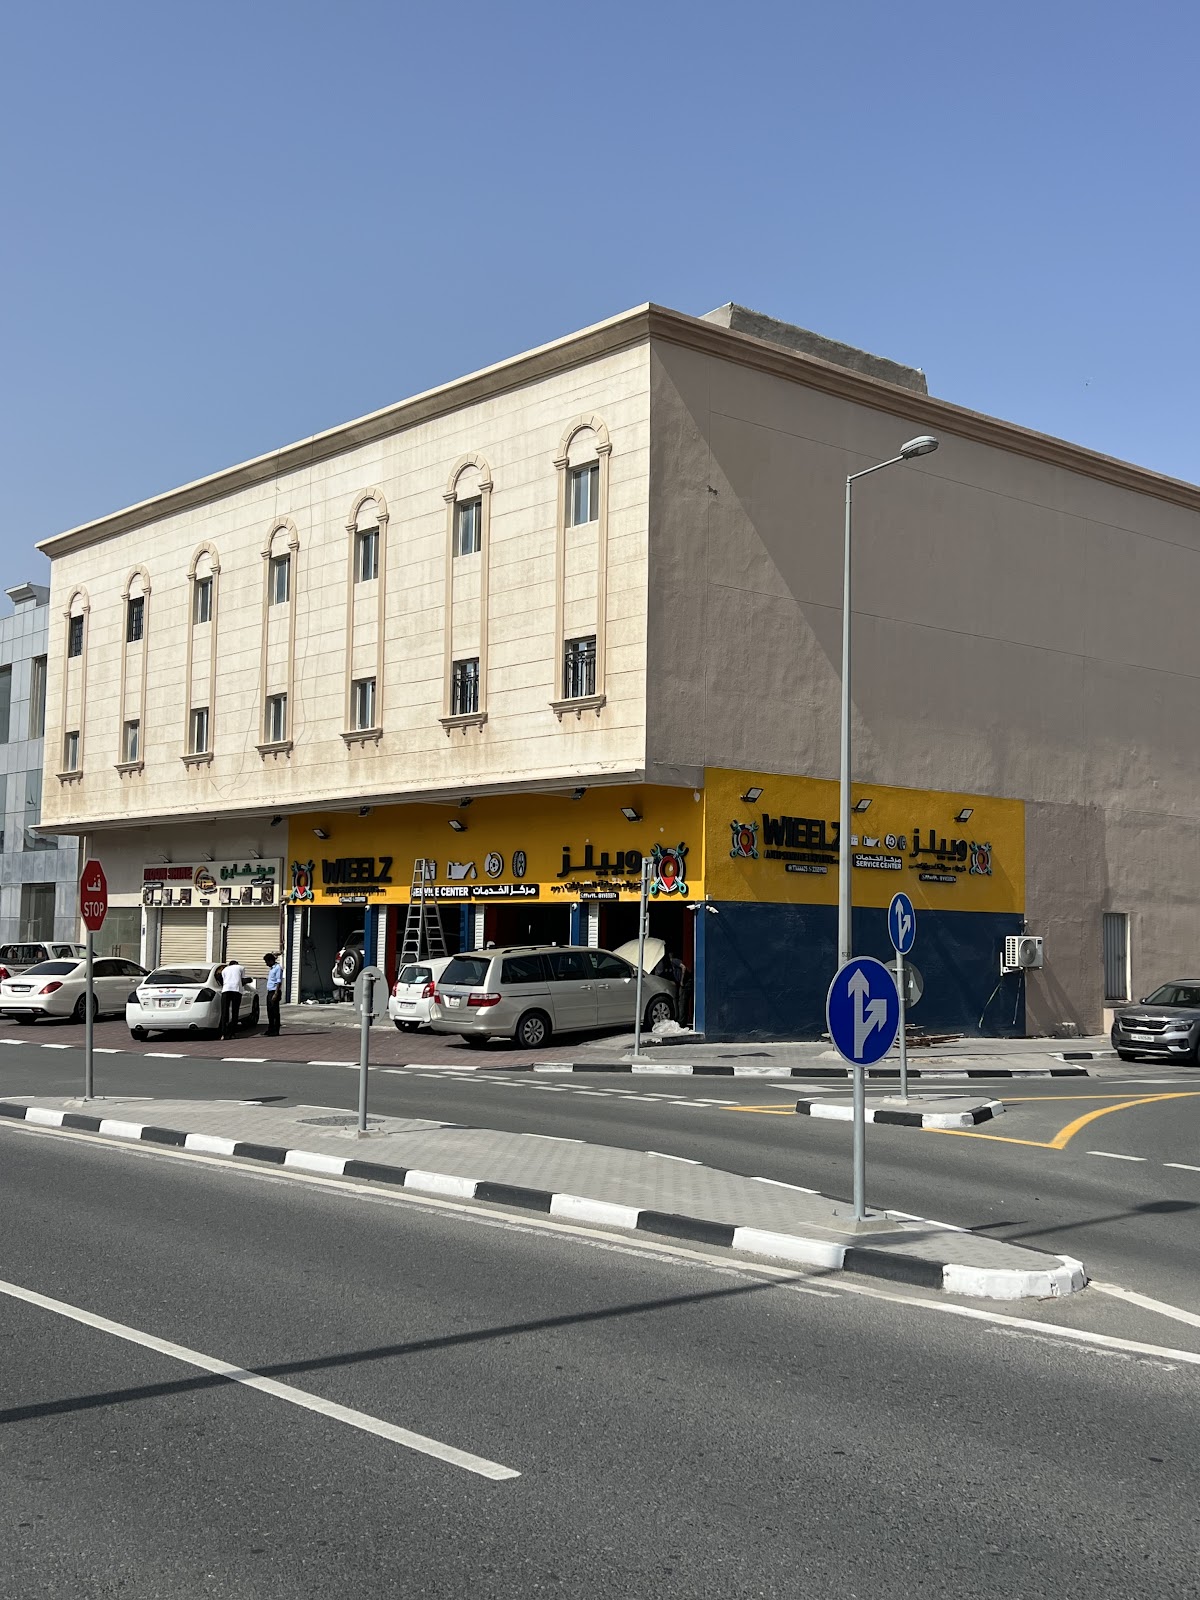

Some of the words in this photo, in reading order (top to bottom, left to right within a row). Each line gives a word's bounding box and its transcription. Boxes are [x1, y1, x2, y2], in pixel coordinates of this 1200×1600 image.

[557, 844, 643, 877] وييلز
[856, 860, 880, 868] SERVICE
[87, 874, 101, 891] قف
[440, 887, 469, 897] CENTER
[472, 885, 509, 896] الخدمات
[510, 884, 536, 896] مركز
[84, 902, 104, 917] STOP
